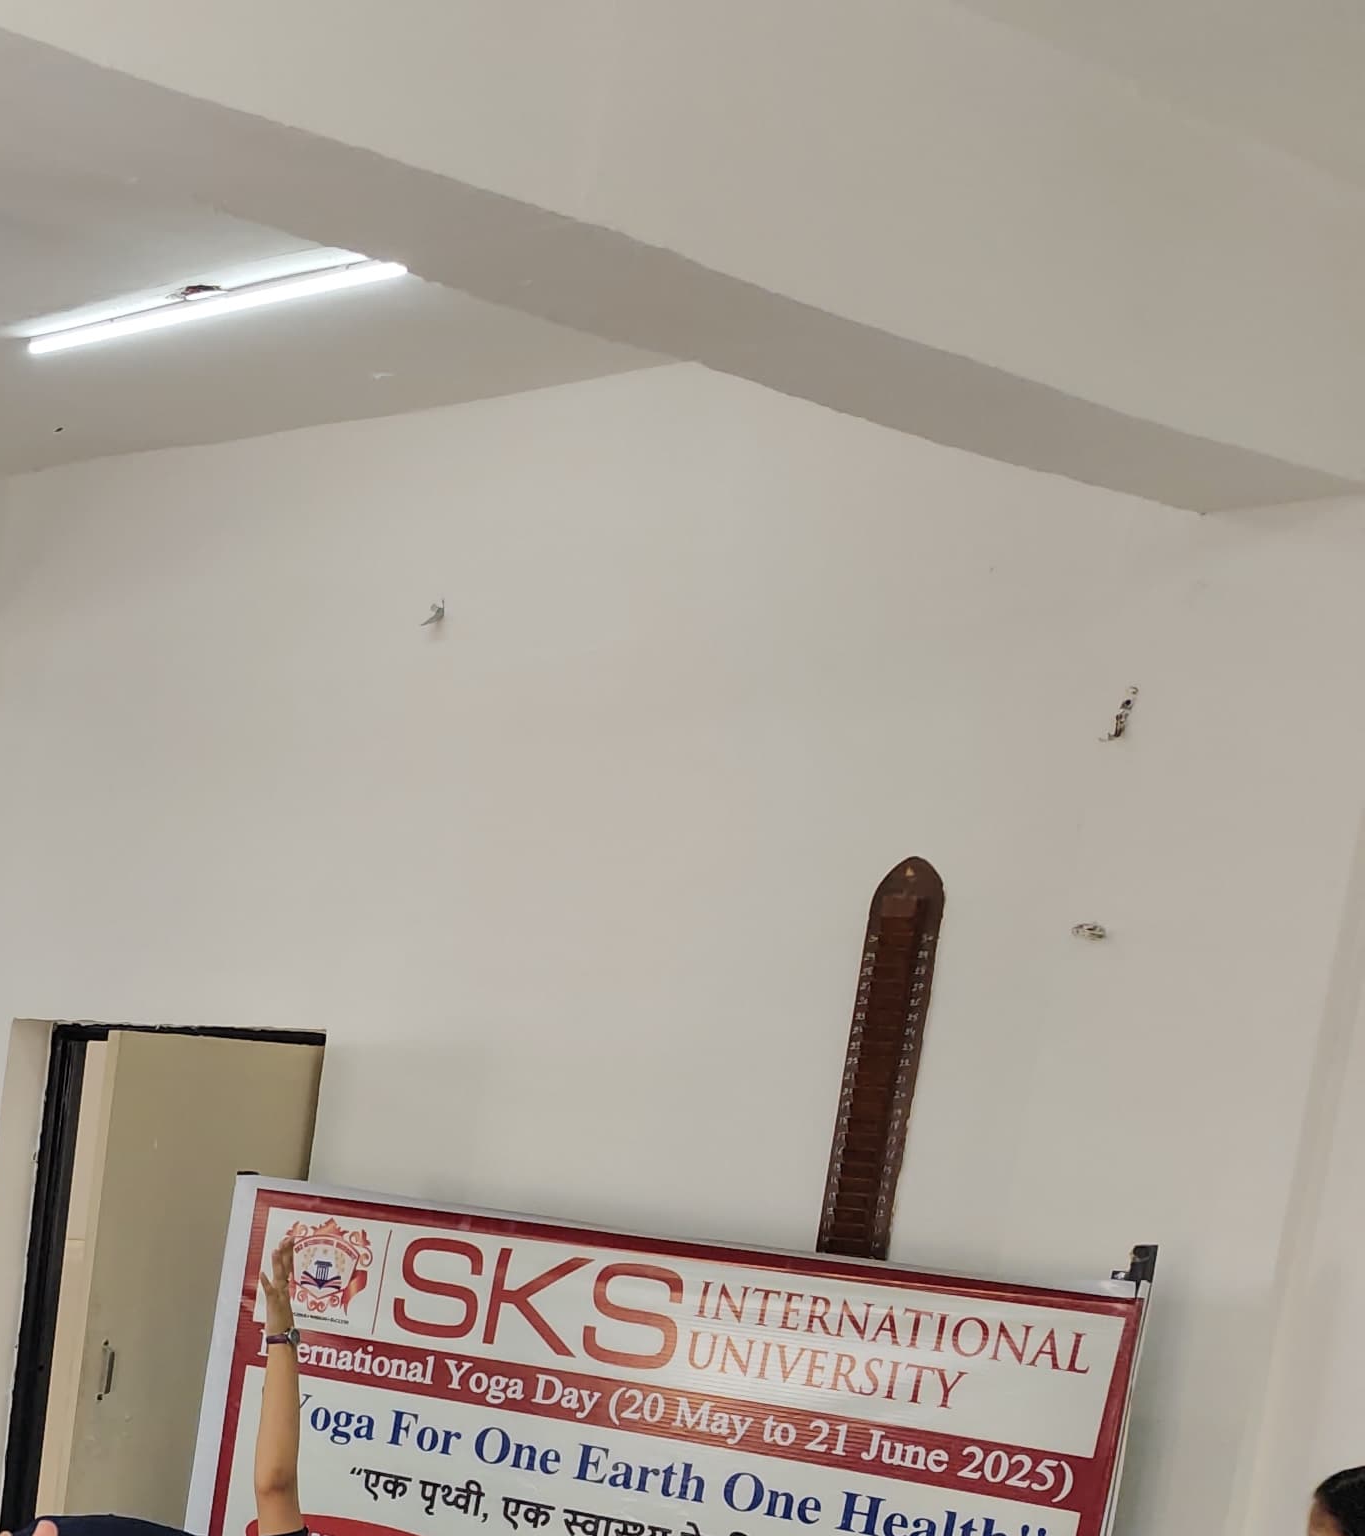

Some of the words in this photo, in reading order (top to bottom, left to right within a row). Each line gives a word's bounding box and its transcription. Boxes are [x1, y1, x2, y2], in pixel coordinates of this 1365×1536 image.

[393, 1237, 685, 1371] SKS
[695, 1280, 1090, 1375] INTERNATIONAL
[257, 1328, 435, 1385] Iernational
[443, 1359, 524, 1404] Yoga
[532, 1373, 602, 1419] Day
[608, 1385, 665, 1426] (20
[671, 1397, 752, 1445] May
[762, 1414, 797, 1447] to
[804, 1420, 848, 1457] 21
[860, 1429, 949, 1473] June
[956, 1446, 1075, 1503] 2025)
[688, 1331, 968, 1409] UNIVERSITY
[386, 1409, 463, 1456] For
[474, 1426, 561, 1475] One
[572, 1443, 706, 1504] Earth
[722, 1471, 823, 1526] One
[419, 1478, 490, 1523] पृथ्वी,
[501, 1496, 556, 1531] एक
